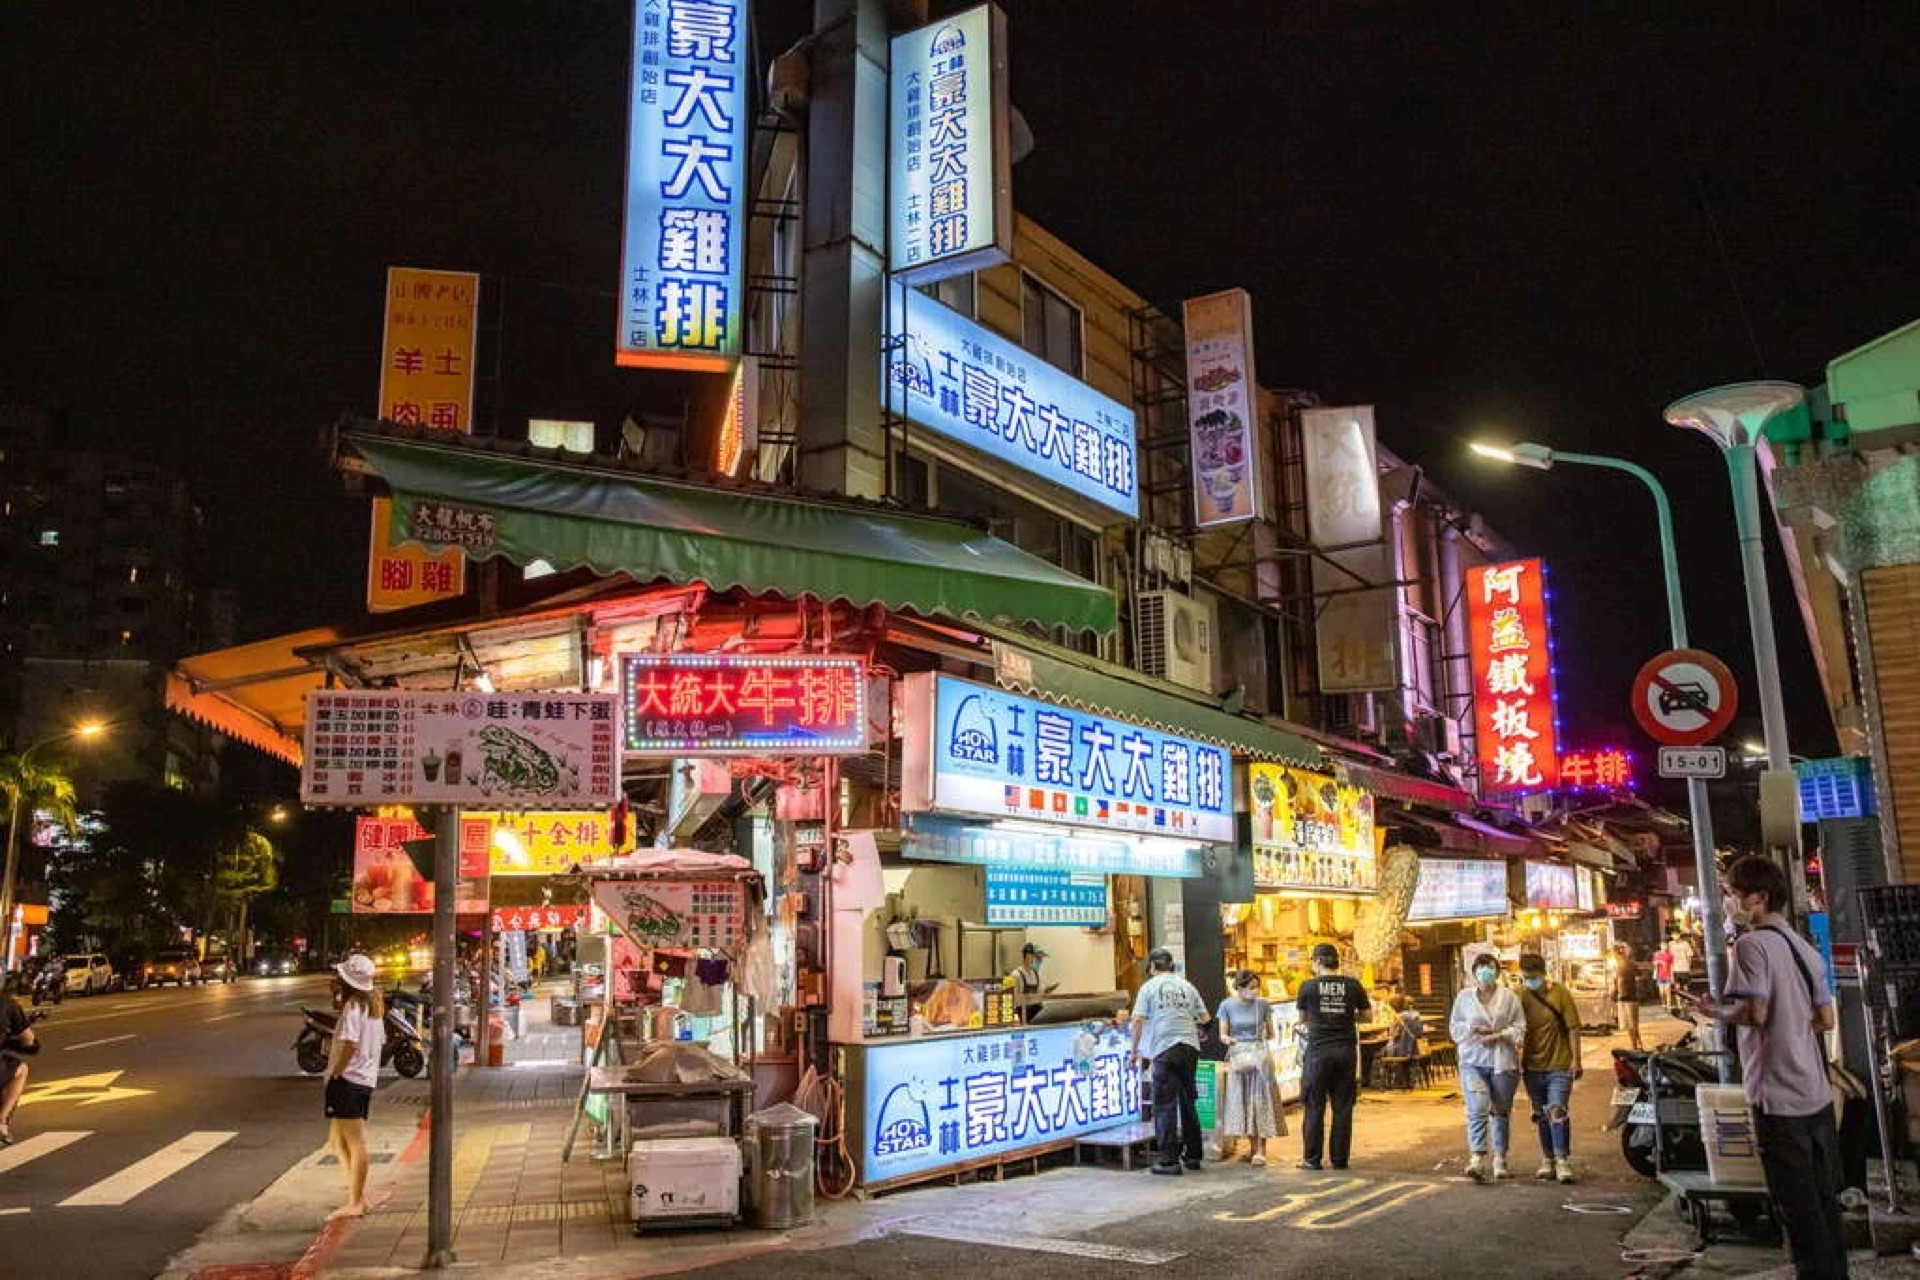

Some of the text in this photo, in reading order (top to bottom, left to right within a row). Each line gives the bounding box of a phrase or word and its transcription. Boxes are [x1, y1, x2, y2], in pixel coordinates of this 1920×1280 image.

[656, 0, 735, 351] 豪大大雞排
[929, 70, 968, 256] 豪大大雞排
[629, 266, 649, 347] 士林二店
[962, 361, 1132, 497] 豪大大雞排
[952, 743, 997, 763] STAR
[957, 731, 990, 747] HOT
[1007, 704, 1026, 777] 士林
[1035, 709, 1224, 812] 豪大大雞排
[1666, 756, 1718, 769] 15-01
[1561, 751, 1629, 786] 牛排
[963, 1038, 1039, 1065] 大雞排創店
[883, 1121, 922, 1141] HOT
[938, 1076, 961, 1155] 士林
[877, 1134, 928, 1155] STAR
